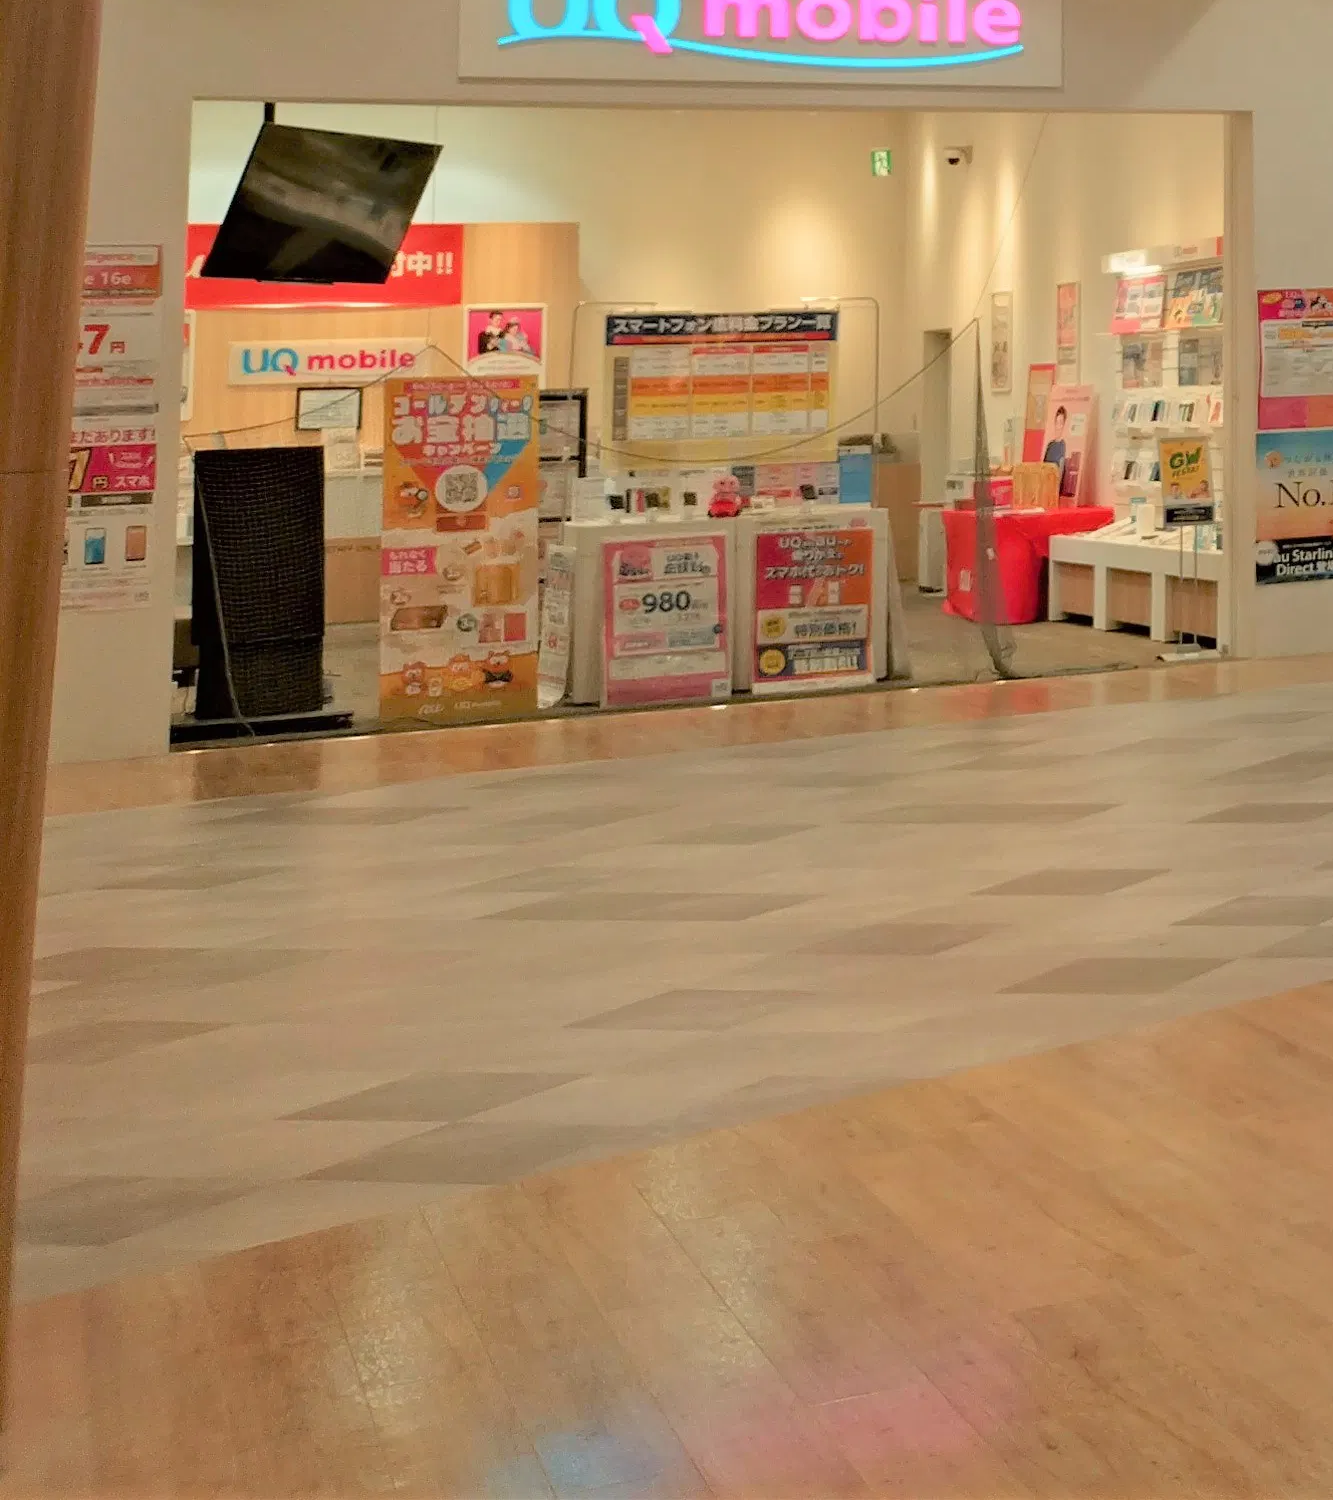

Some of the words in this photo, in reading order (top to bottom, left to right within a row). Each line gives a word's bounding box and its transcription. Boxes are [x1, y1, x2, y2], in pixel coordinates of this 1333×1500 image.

[241, 347, 299, 376] UQ
[306, 348, 416, 372] mobile
[641, 590, 692, 614] 980
